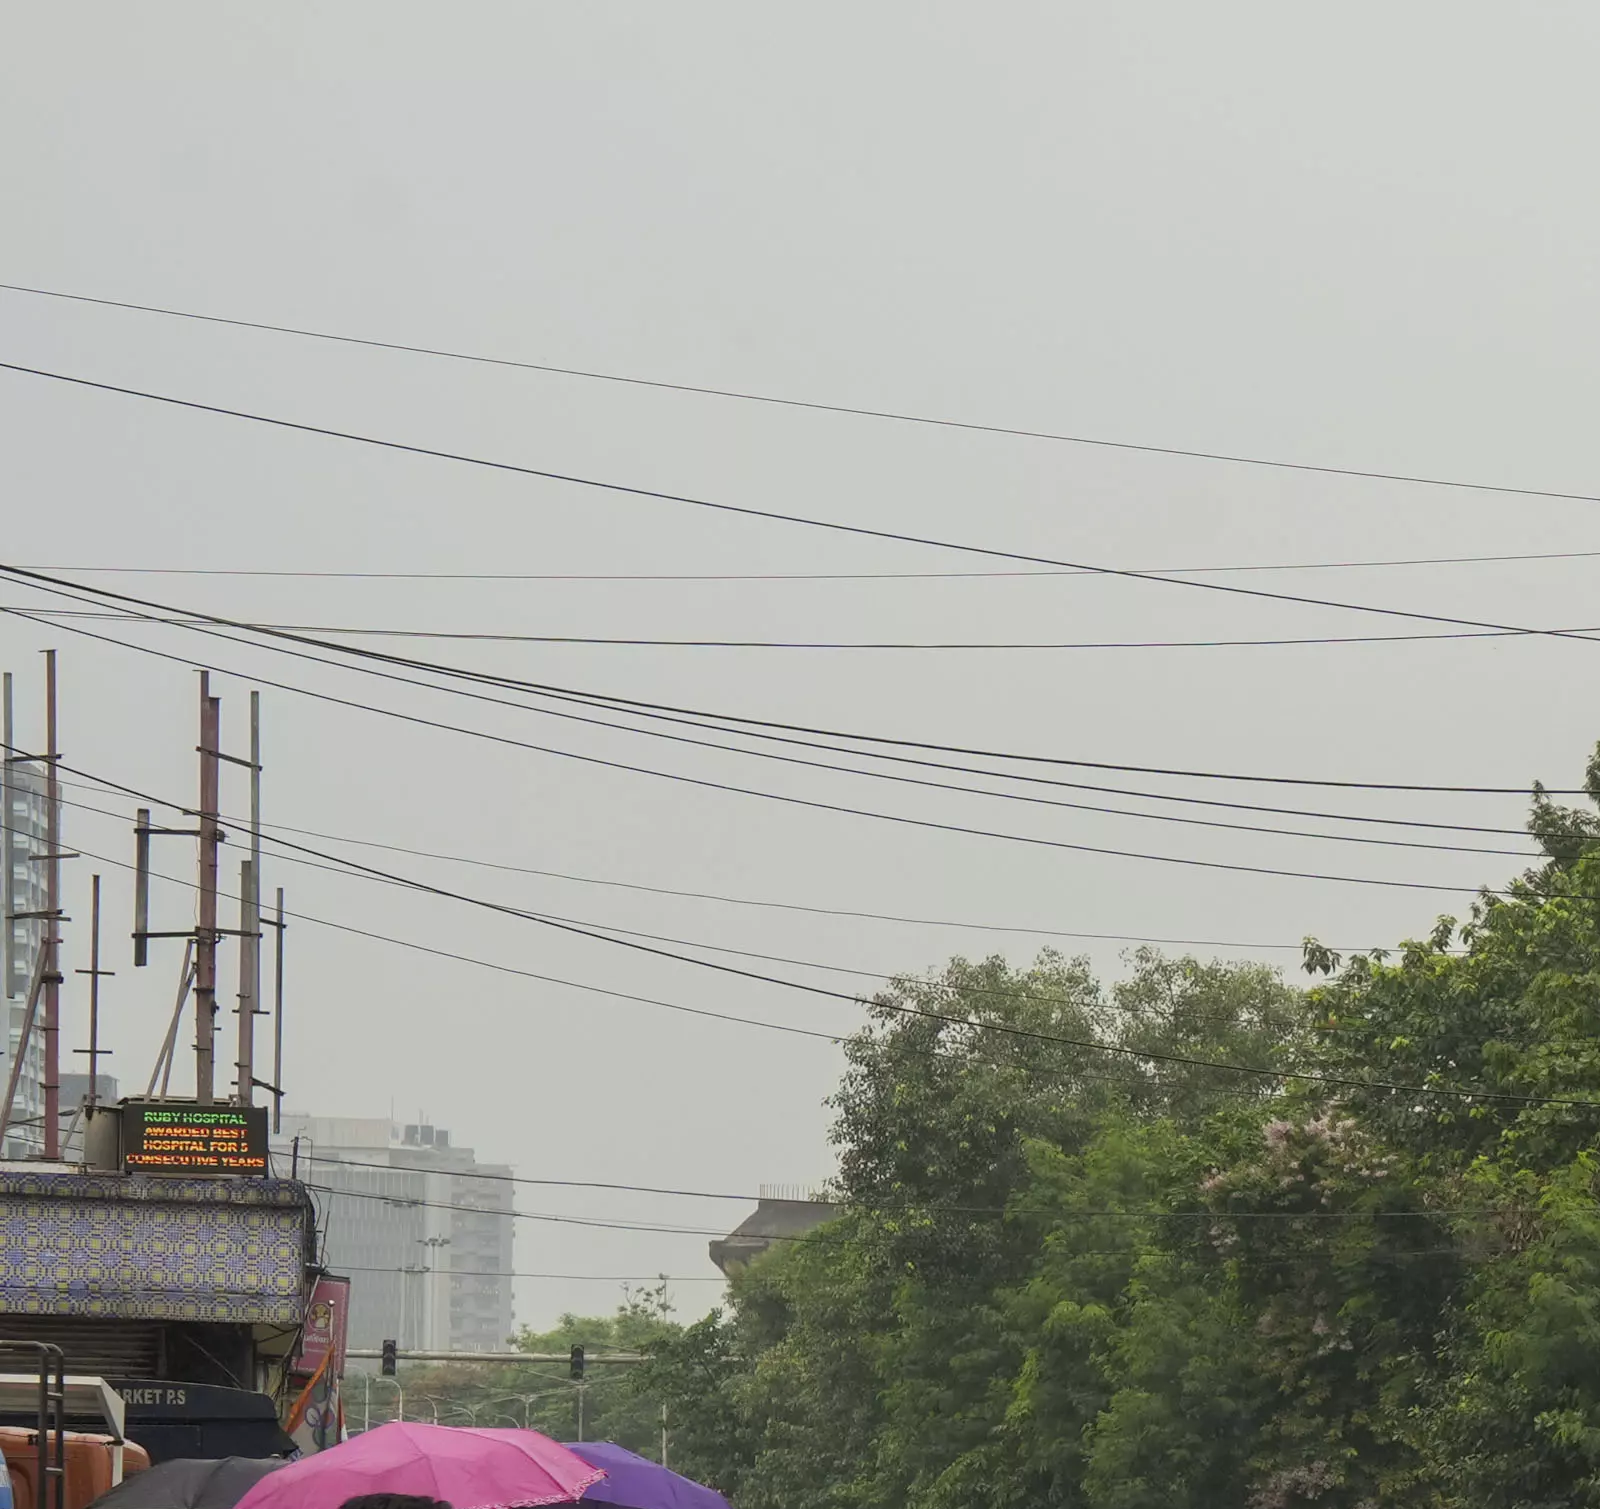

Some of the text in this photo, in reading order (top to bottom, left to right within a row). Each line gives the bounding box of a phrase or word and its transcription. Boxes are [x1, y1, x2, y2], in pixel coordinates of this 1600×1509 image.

[144, 1111, 247, 1124] RUBY HOSPITAL
[143, 1127, 247, 1138] AWARDED BEST
[143, 1140, 207, 1151] HOSPITAL
[210, 1141, 238, 1152] FOR
[126, 1154, 265, 1167] CONSECUTIVE YEARS
[115, 1388, 162, 1404] RKET
